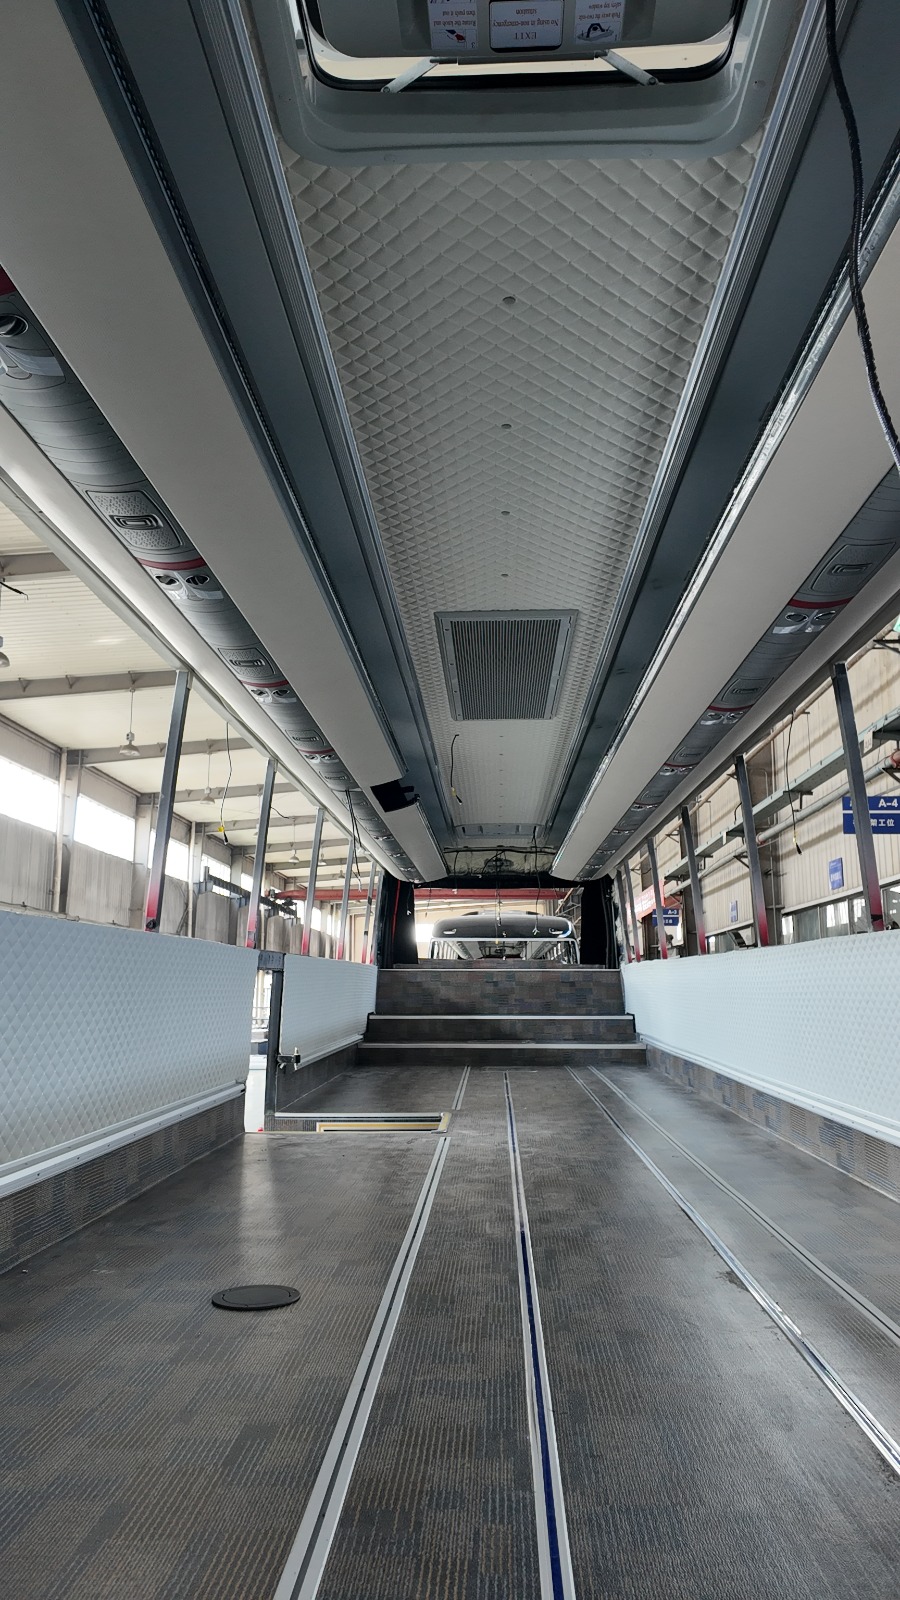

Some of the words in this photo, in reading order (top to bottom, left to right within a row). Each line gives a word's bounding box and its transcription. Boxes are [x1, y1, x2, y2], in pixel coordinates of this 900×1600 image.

[515, 8, 537, 16] situation
[536, 18, 550, 26] using
[514, 32, 537, 40] EXIT
[878, 798, 899, 808] A-4
